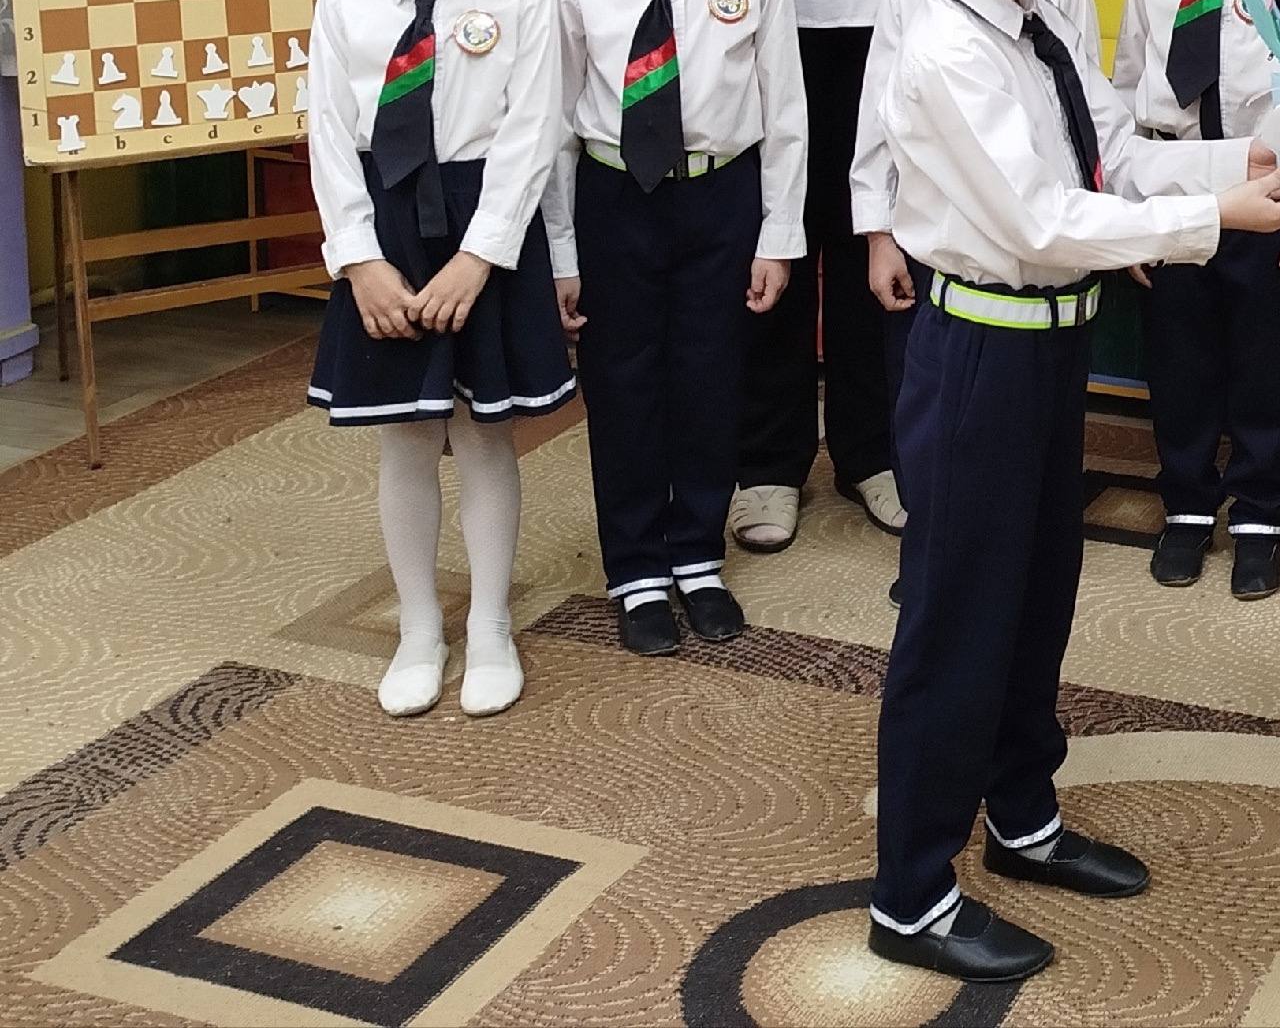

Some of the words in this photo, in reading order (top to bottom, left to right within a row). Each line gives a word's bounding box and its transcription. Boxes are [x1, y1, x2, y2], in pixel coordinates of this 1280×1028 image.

[23, 27, 34, 41] 3
[26, 70, 37, 85] 2
[31, 113, 39, 127] 1
[115, 135, 126, 150] b
[163, 134, 173, 145] c
[208, 125, 219, 140] d
[253, 123, 263, 135] e
[296, 114, 305, 130] f
